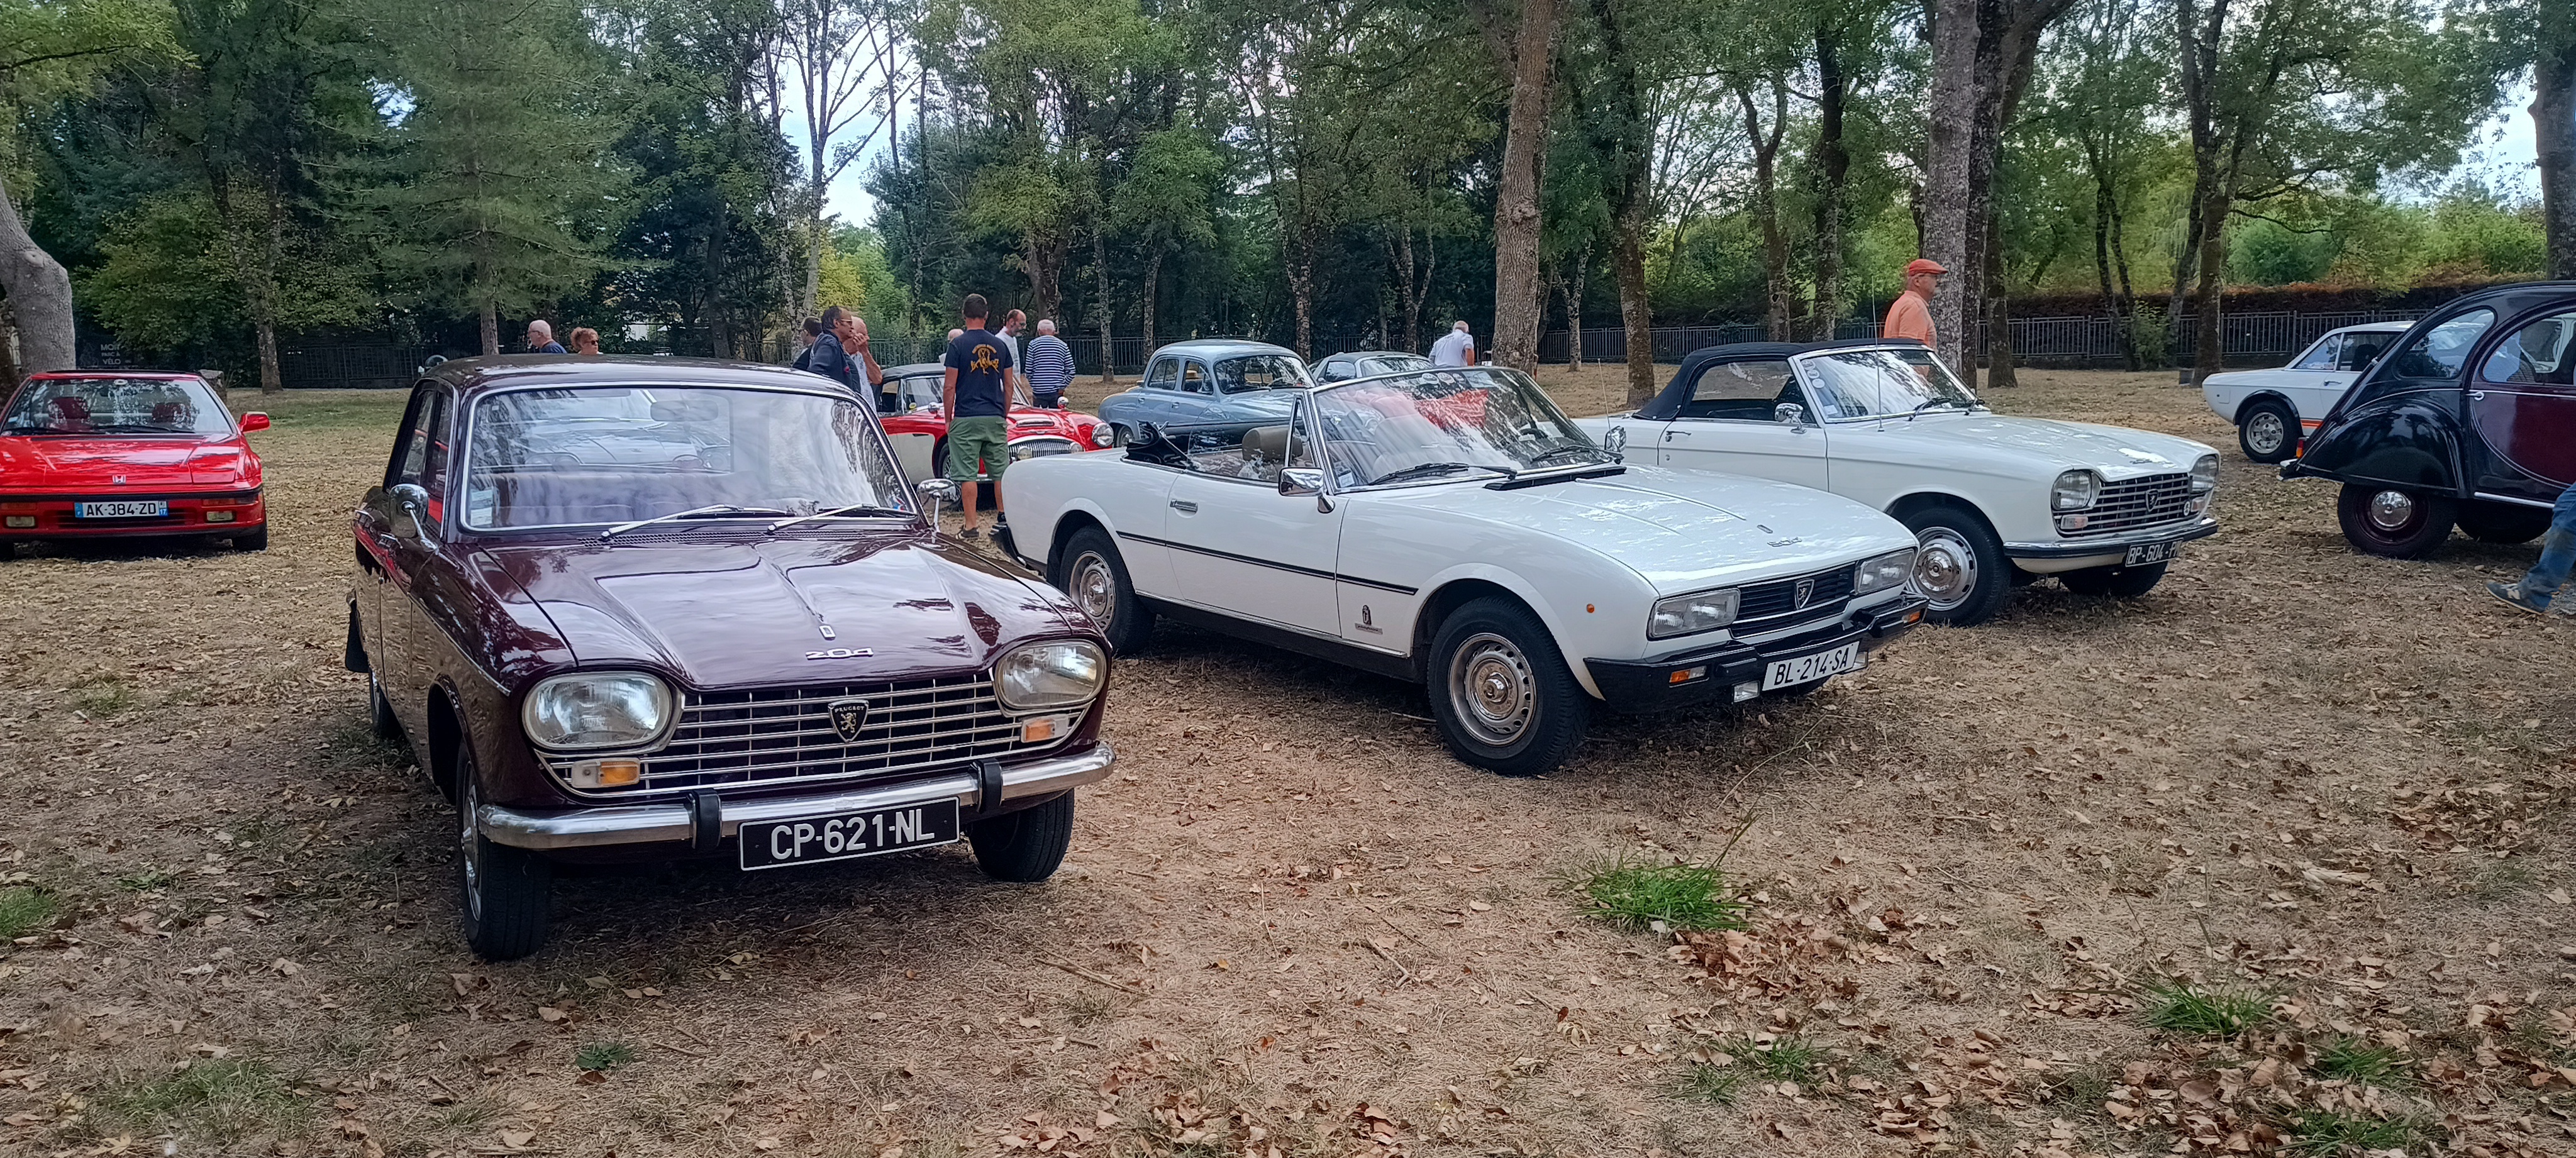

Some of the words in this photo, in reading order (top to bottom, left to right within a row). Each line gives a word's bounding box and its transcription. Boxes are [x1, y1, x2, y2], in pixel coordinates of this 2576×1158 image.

[86, 503, 157, 516] AK-384-ZD
[805, 647, 874, 660] 204
[1774, 647, 1850, 686] BL-214-SA
[771, 808, 935, 860] CP-621-NL
